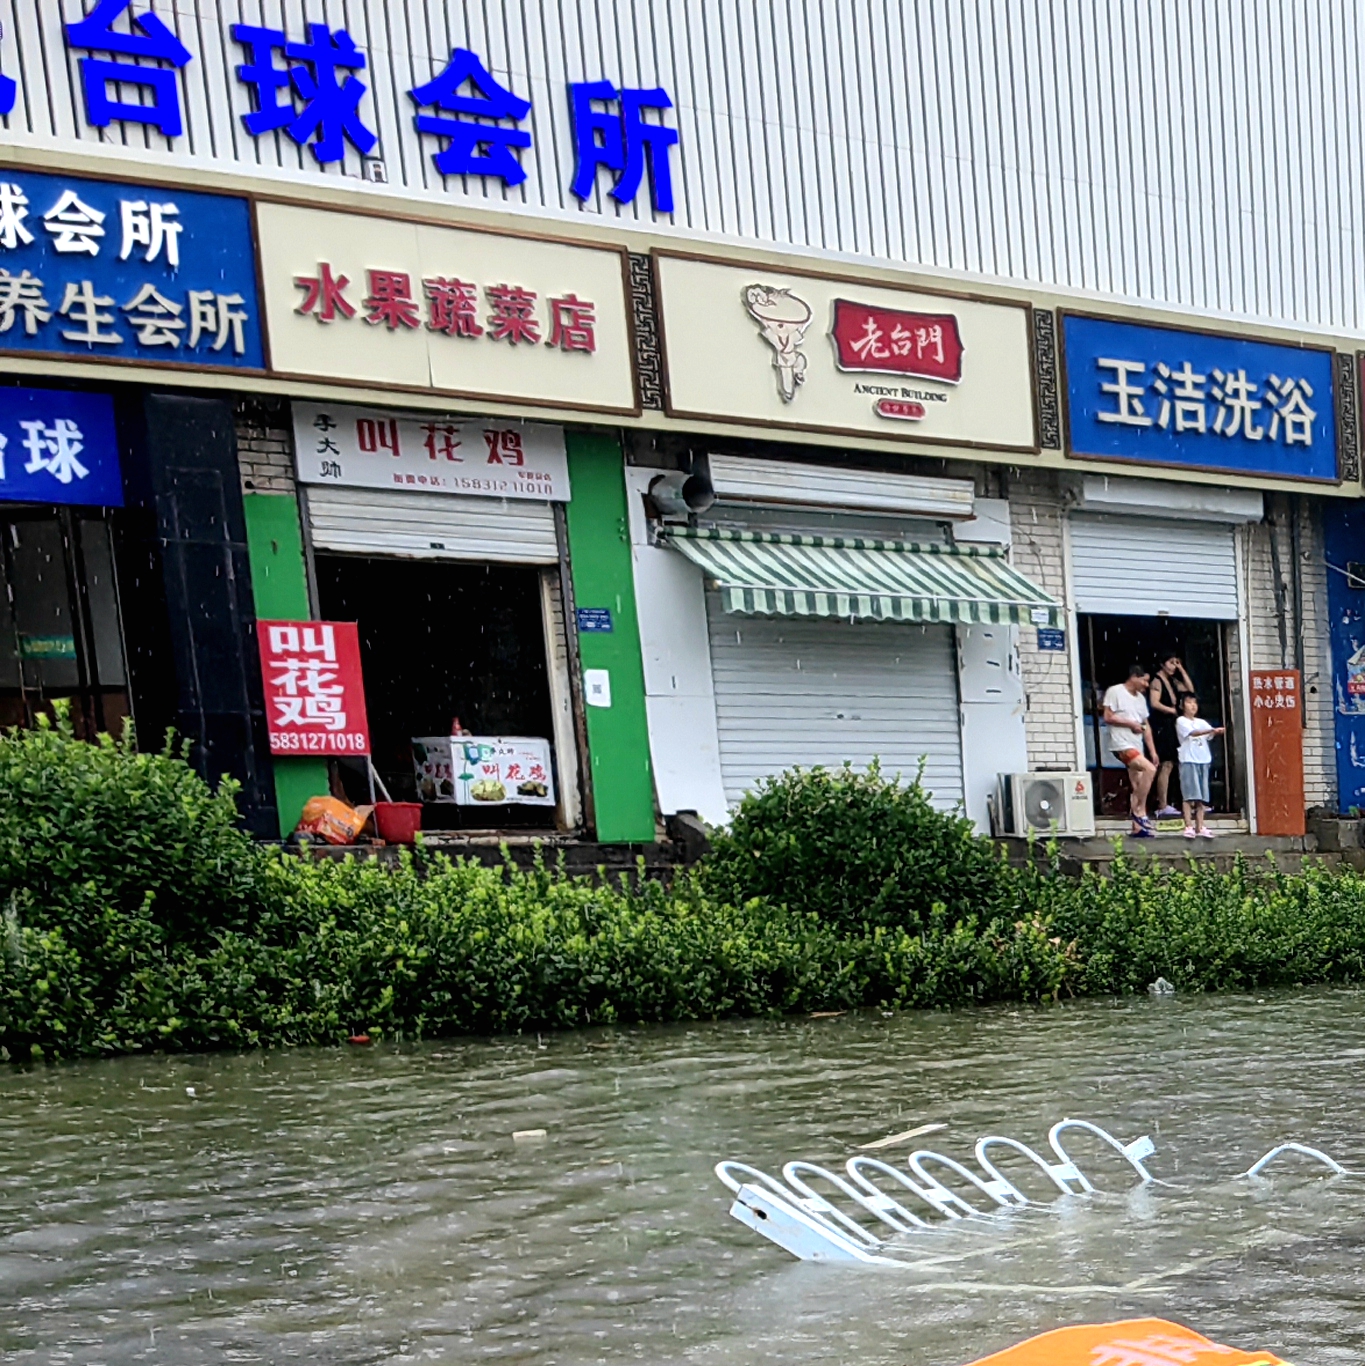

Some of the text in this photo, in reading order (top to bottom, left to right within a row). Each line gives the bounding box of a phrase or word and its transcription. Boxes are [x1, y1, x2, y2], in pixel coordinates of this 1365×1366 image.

[293, 262, 597, 354] 水果蔬菜店
[356, 418, 525, 467] 叫花鸡
[1097, 357, 1317, 446] 玉洁洗浴
[0, 418, 90, 484] 球
[269, 625, 347, 731] 叫花鸡
